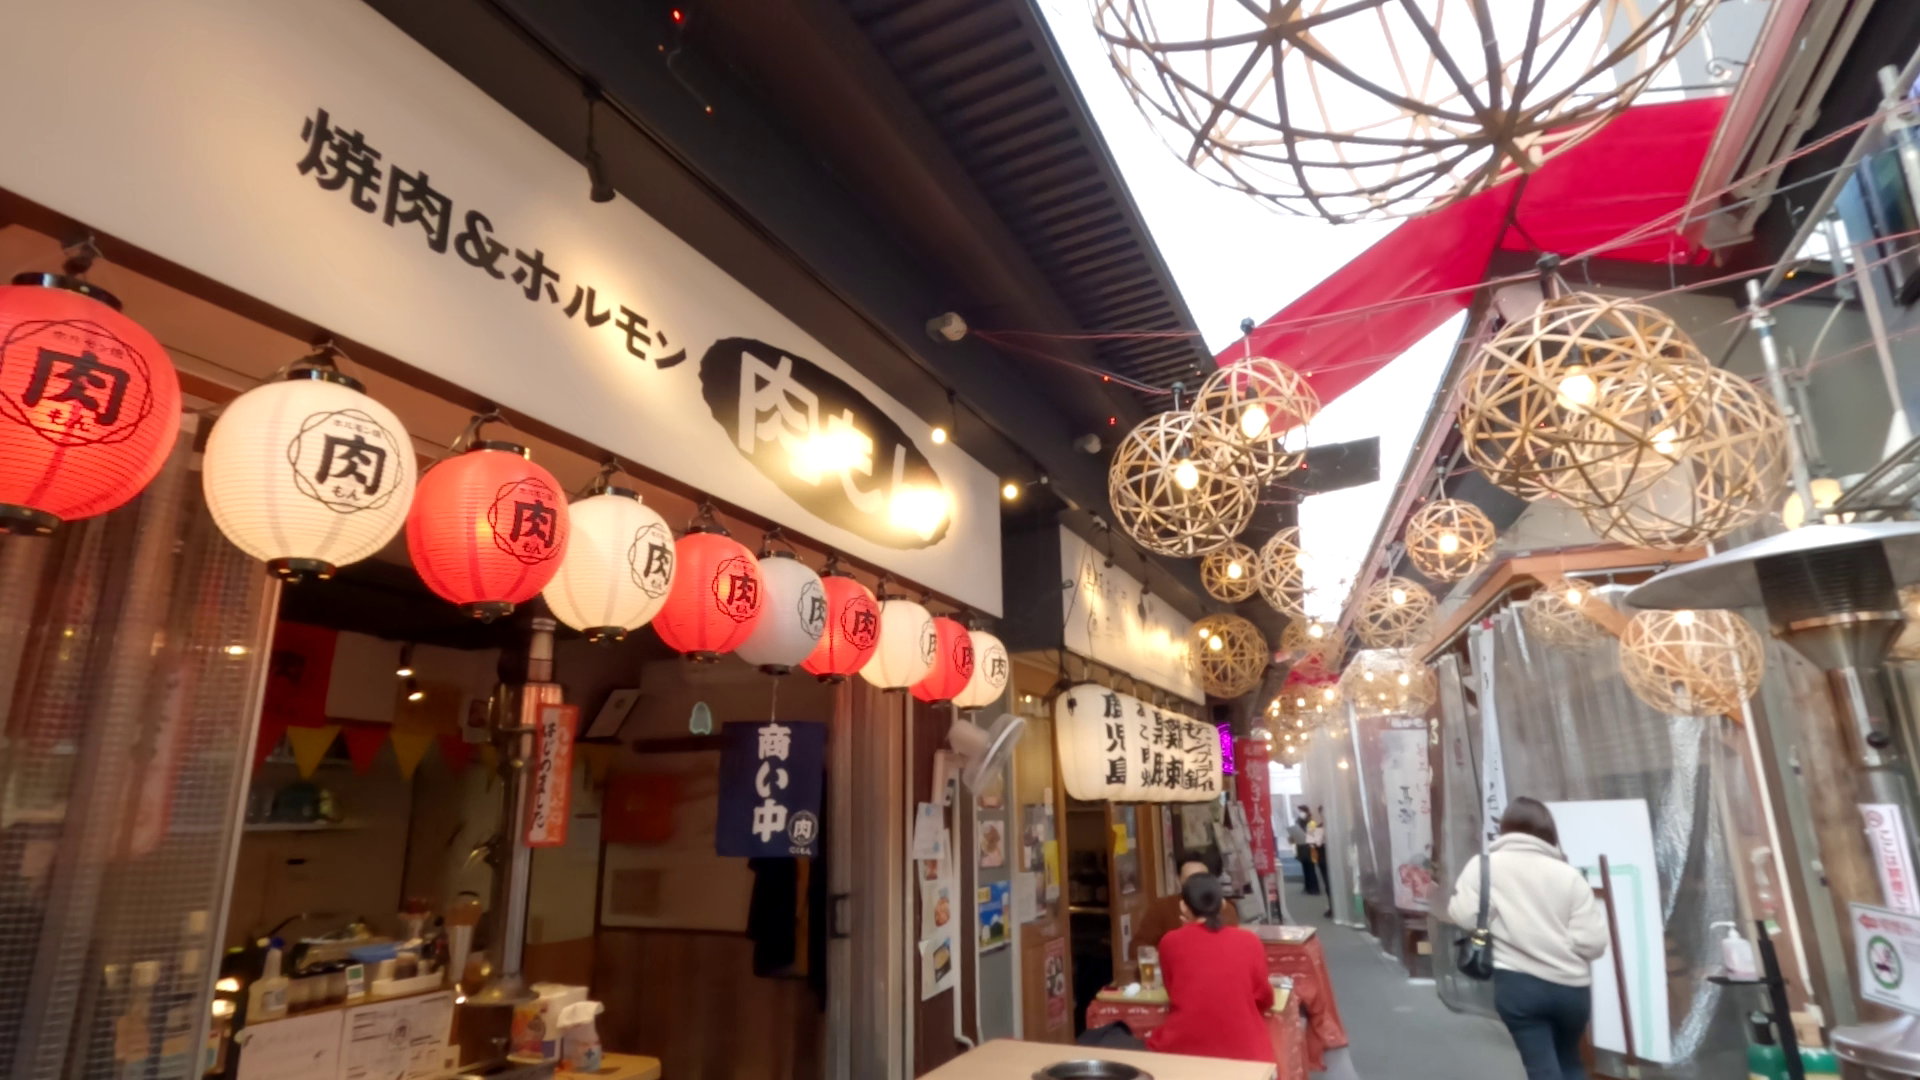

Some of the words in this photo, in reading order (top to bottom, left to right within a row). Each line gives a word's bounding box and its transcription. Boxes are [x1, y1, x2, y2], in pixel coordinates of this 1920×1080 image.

[296, 106, 687, 370] 焼肉&ホルモン
[21, 346, 131, 427] 肉
[315, 433, 387, 496] 肉
[332, 485, 361, 501] もん
[509, 500, 557, 548] 肉
[643, 542, 674, 586] 肉
[727, 572, 758, 610] 肉
[852, 609, 877, 641] 肉
[991, 657, 1006, 679] 肉
[1101, 692, 1127, 785] 鹿児島
[752, 723, 792, 843] 商い中
[793, 818, 813, 839] 肉
